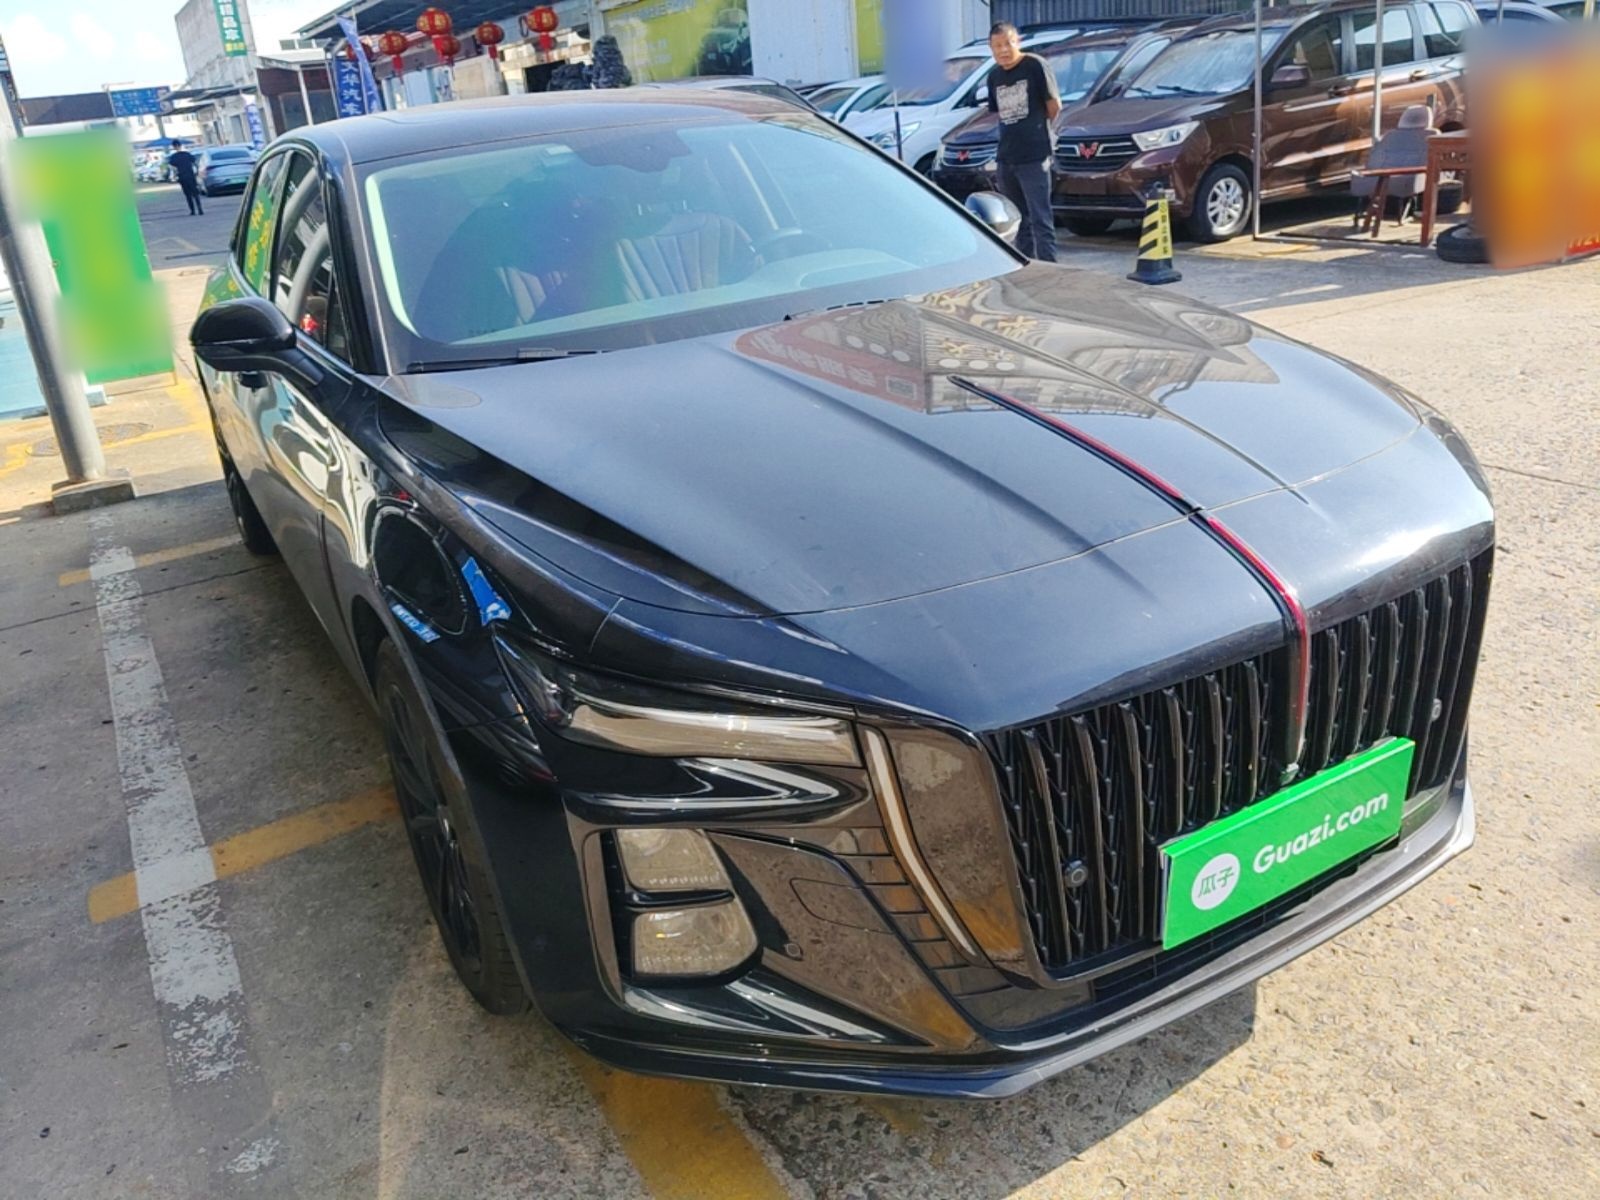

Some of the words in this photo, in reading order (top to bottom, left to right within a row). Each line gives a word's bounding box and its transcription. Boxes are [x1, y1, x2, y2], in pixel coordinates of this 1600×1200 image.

[340, 61, 363, 116] 大华汽车
[1253, 792, 1389, 874] Guazi.com
[1198, 866, 1235, 898] 瓜子
